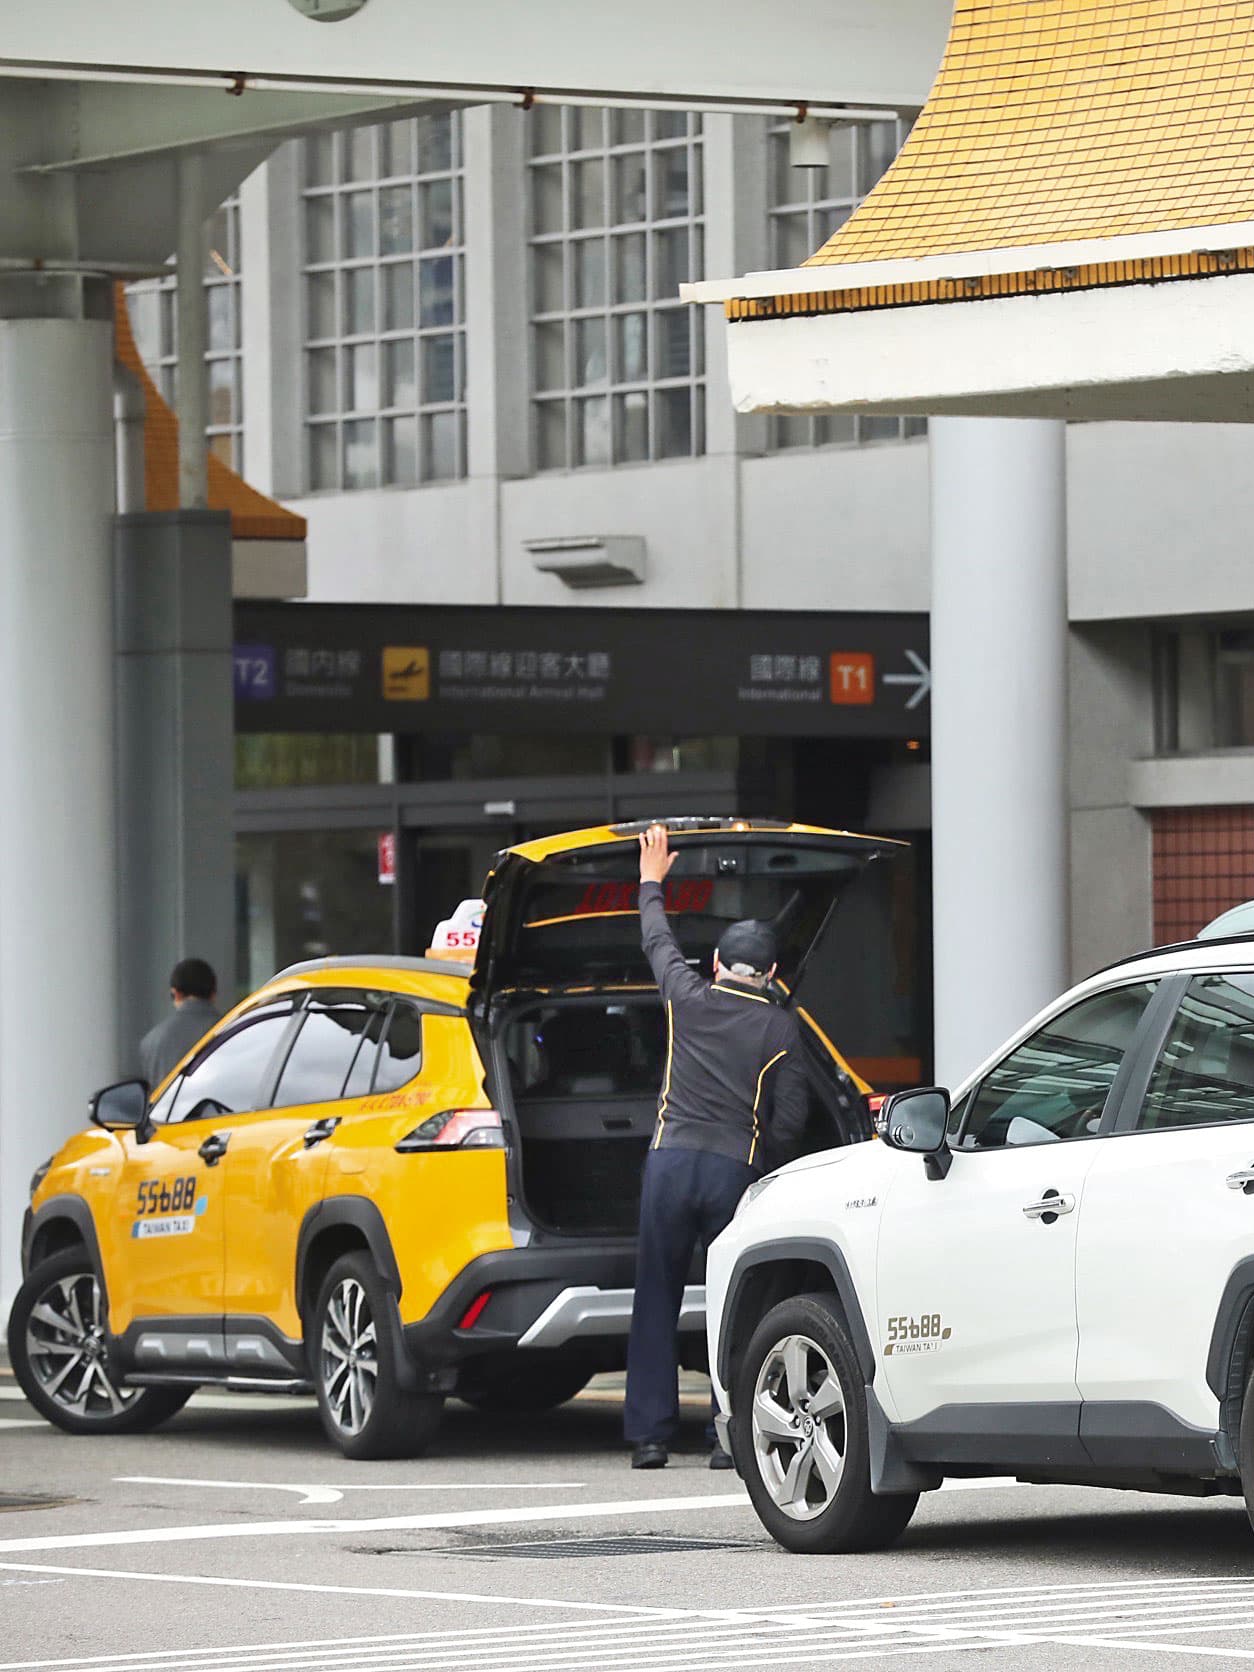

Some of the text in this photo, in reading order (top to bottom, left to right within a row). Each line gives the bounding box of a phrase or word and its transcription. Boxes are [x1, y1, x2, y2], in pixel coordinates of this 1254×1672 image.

[236, 658, 269, 685] T2
[838, 664, 867, 690] T1
[136, 1176, 197, 1216] 55688
[887, 1314, 941, 1341] 55688
[896, 1344, 921, 1353] TAIWAN
